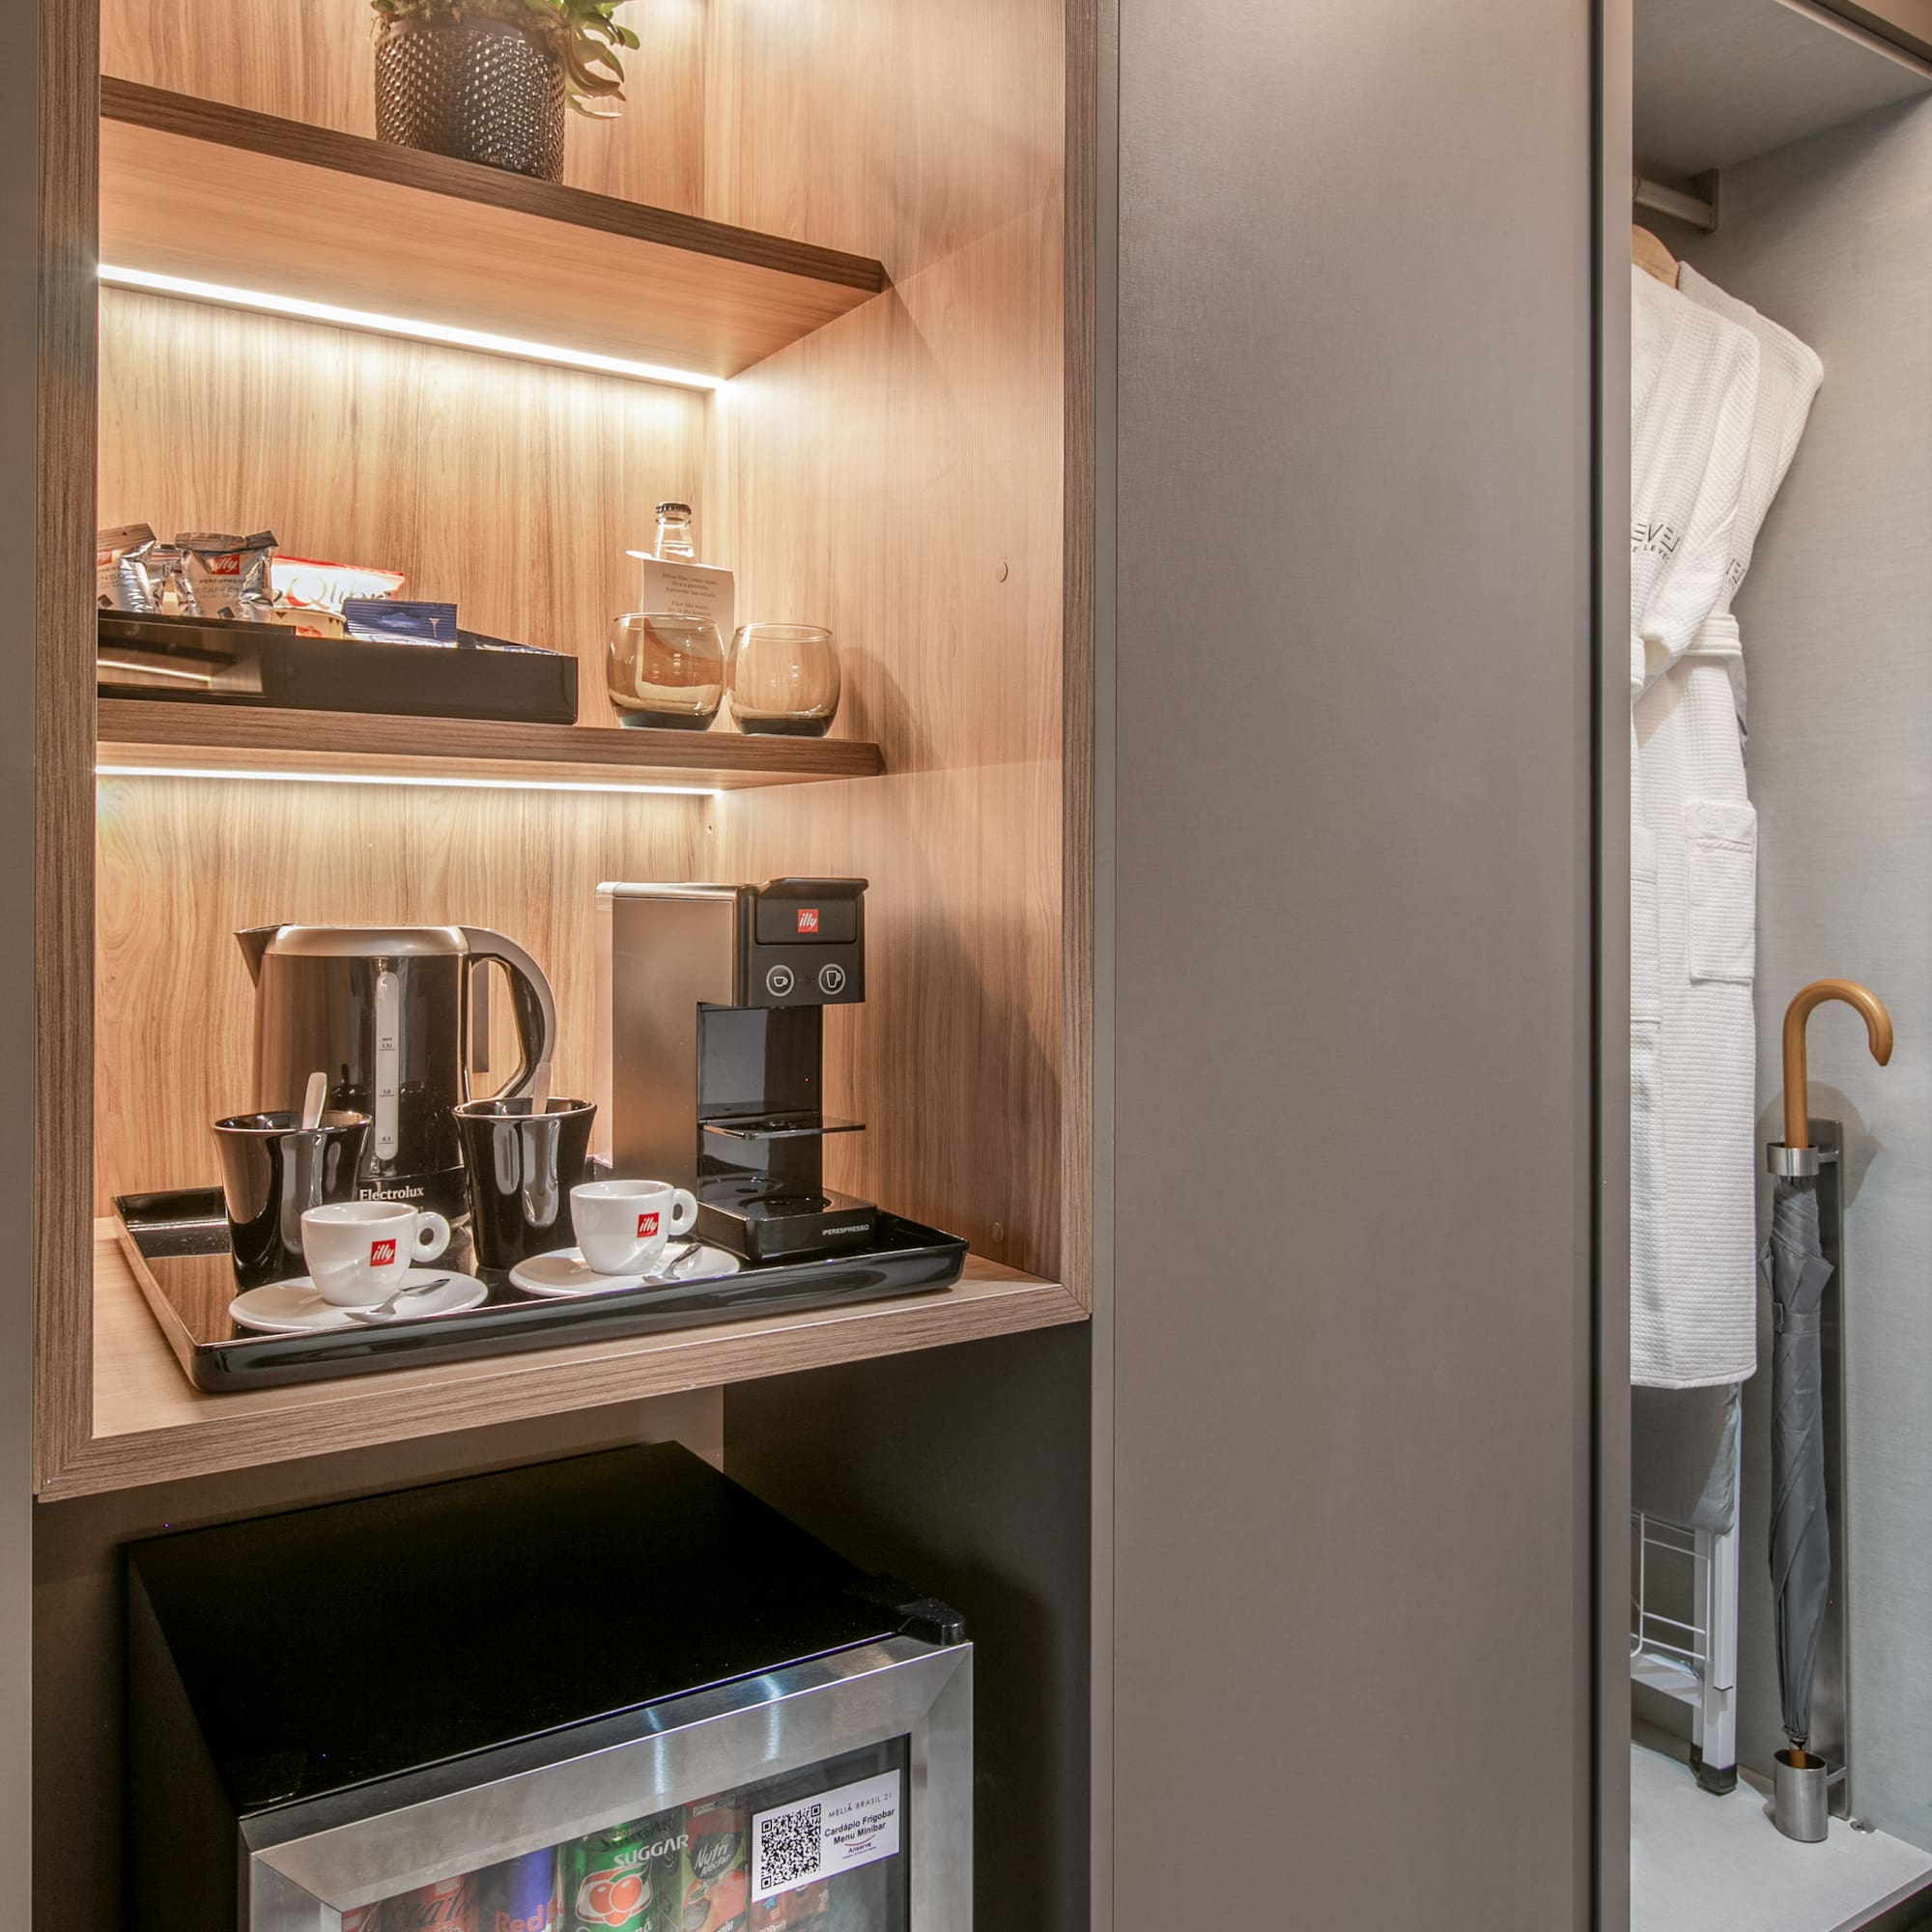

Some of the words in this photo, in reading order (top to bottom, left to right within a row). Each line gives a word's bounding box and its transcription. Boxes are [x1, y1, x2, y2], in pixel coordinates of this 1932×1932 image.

[1631, 523, 1681, 553] EVEL
[799, 912, 817, 928] illy
[359, 1184, 424, 1202] Electrolux
[639, 1215, 658, 1235] illy
[821, 1224, 869, 1236] IPERESPRESSO
[372, 1243, 395, 1263] illy
[856, 1796, 881, 1809] BRASIL
[824, 1819, 861, 1837] Cardápio
[862, 1808, 895, 1825] Frigobar
[834, 1833, 856, 1846] Menu
[857, 1822, 887, 1837] Minibar
[613, 1834, 689, 1867] SUGGAR
[694, 1842, 729, 1871] Nutri
[495, 1904, 545, 1932] Red
